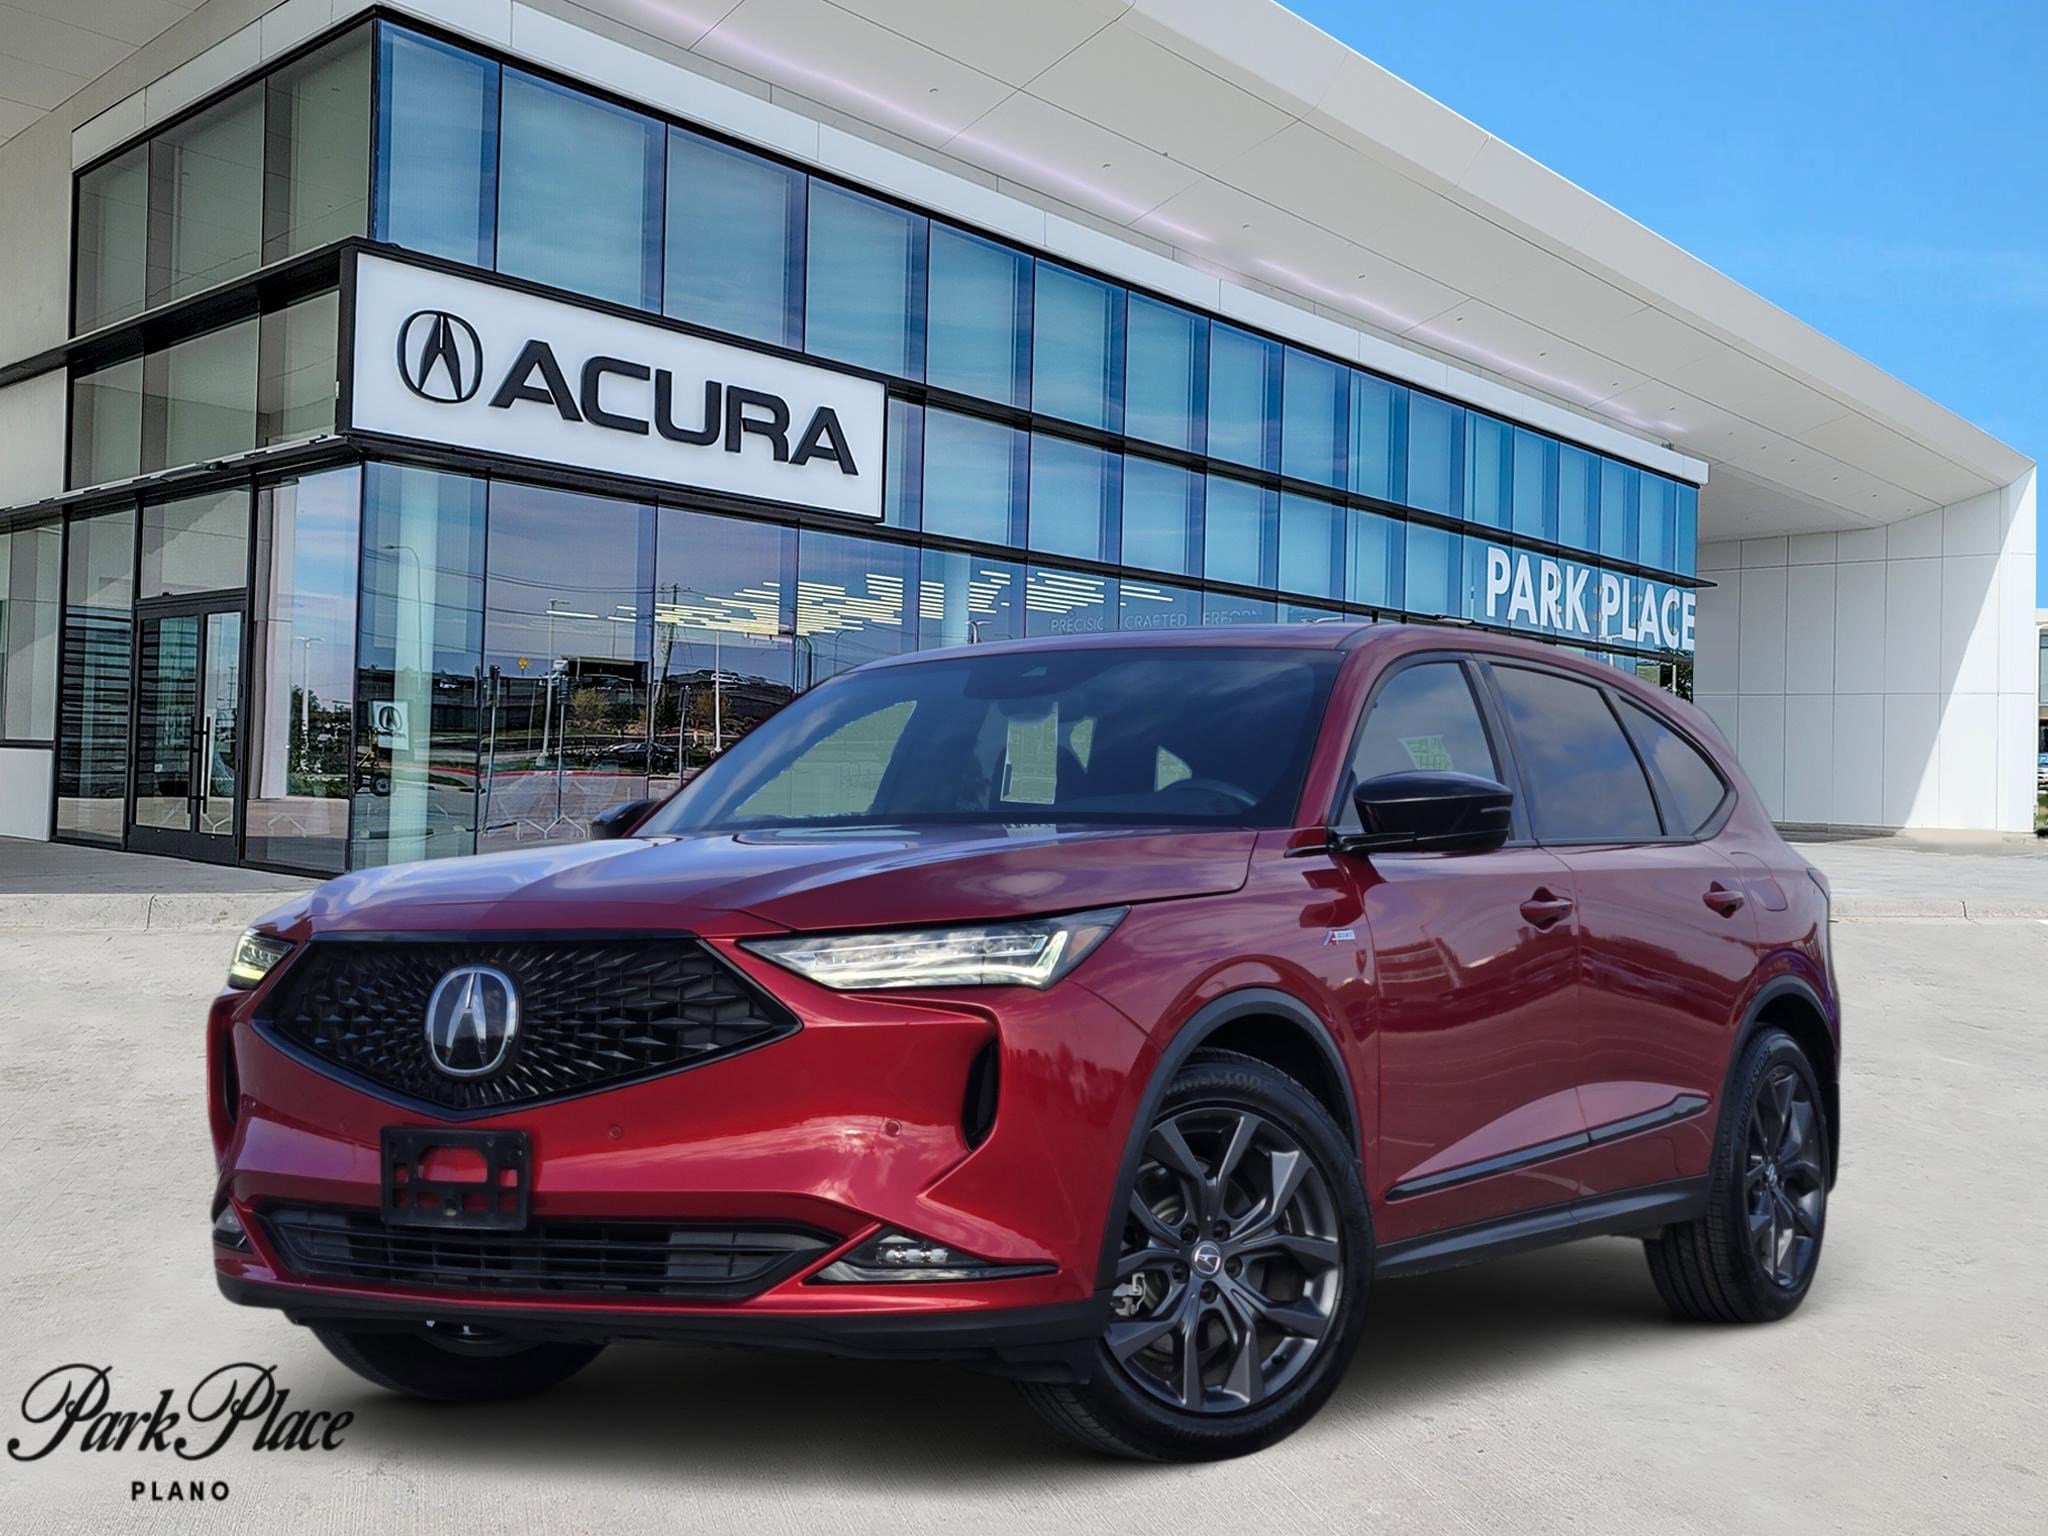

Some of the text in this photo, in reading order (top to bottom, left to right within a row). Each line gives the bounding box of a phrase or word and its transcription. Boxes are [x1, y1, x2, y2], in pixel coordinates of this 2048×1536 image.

[488, 339, 859, 476] ACURA
[1124, 613, 1188, 629] CRAFTED
[1486, 546, 1696, 650] PARK PLACE
